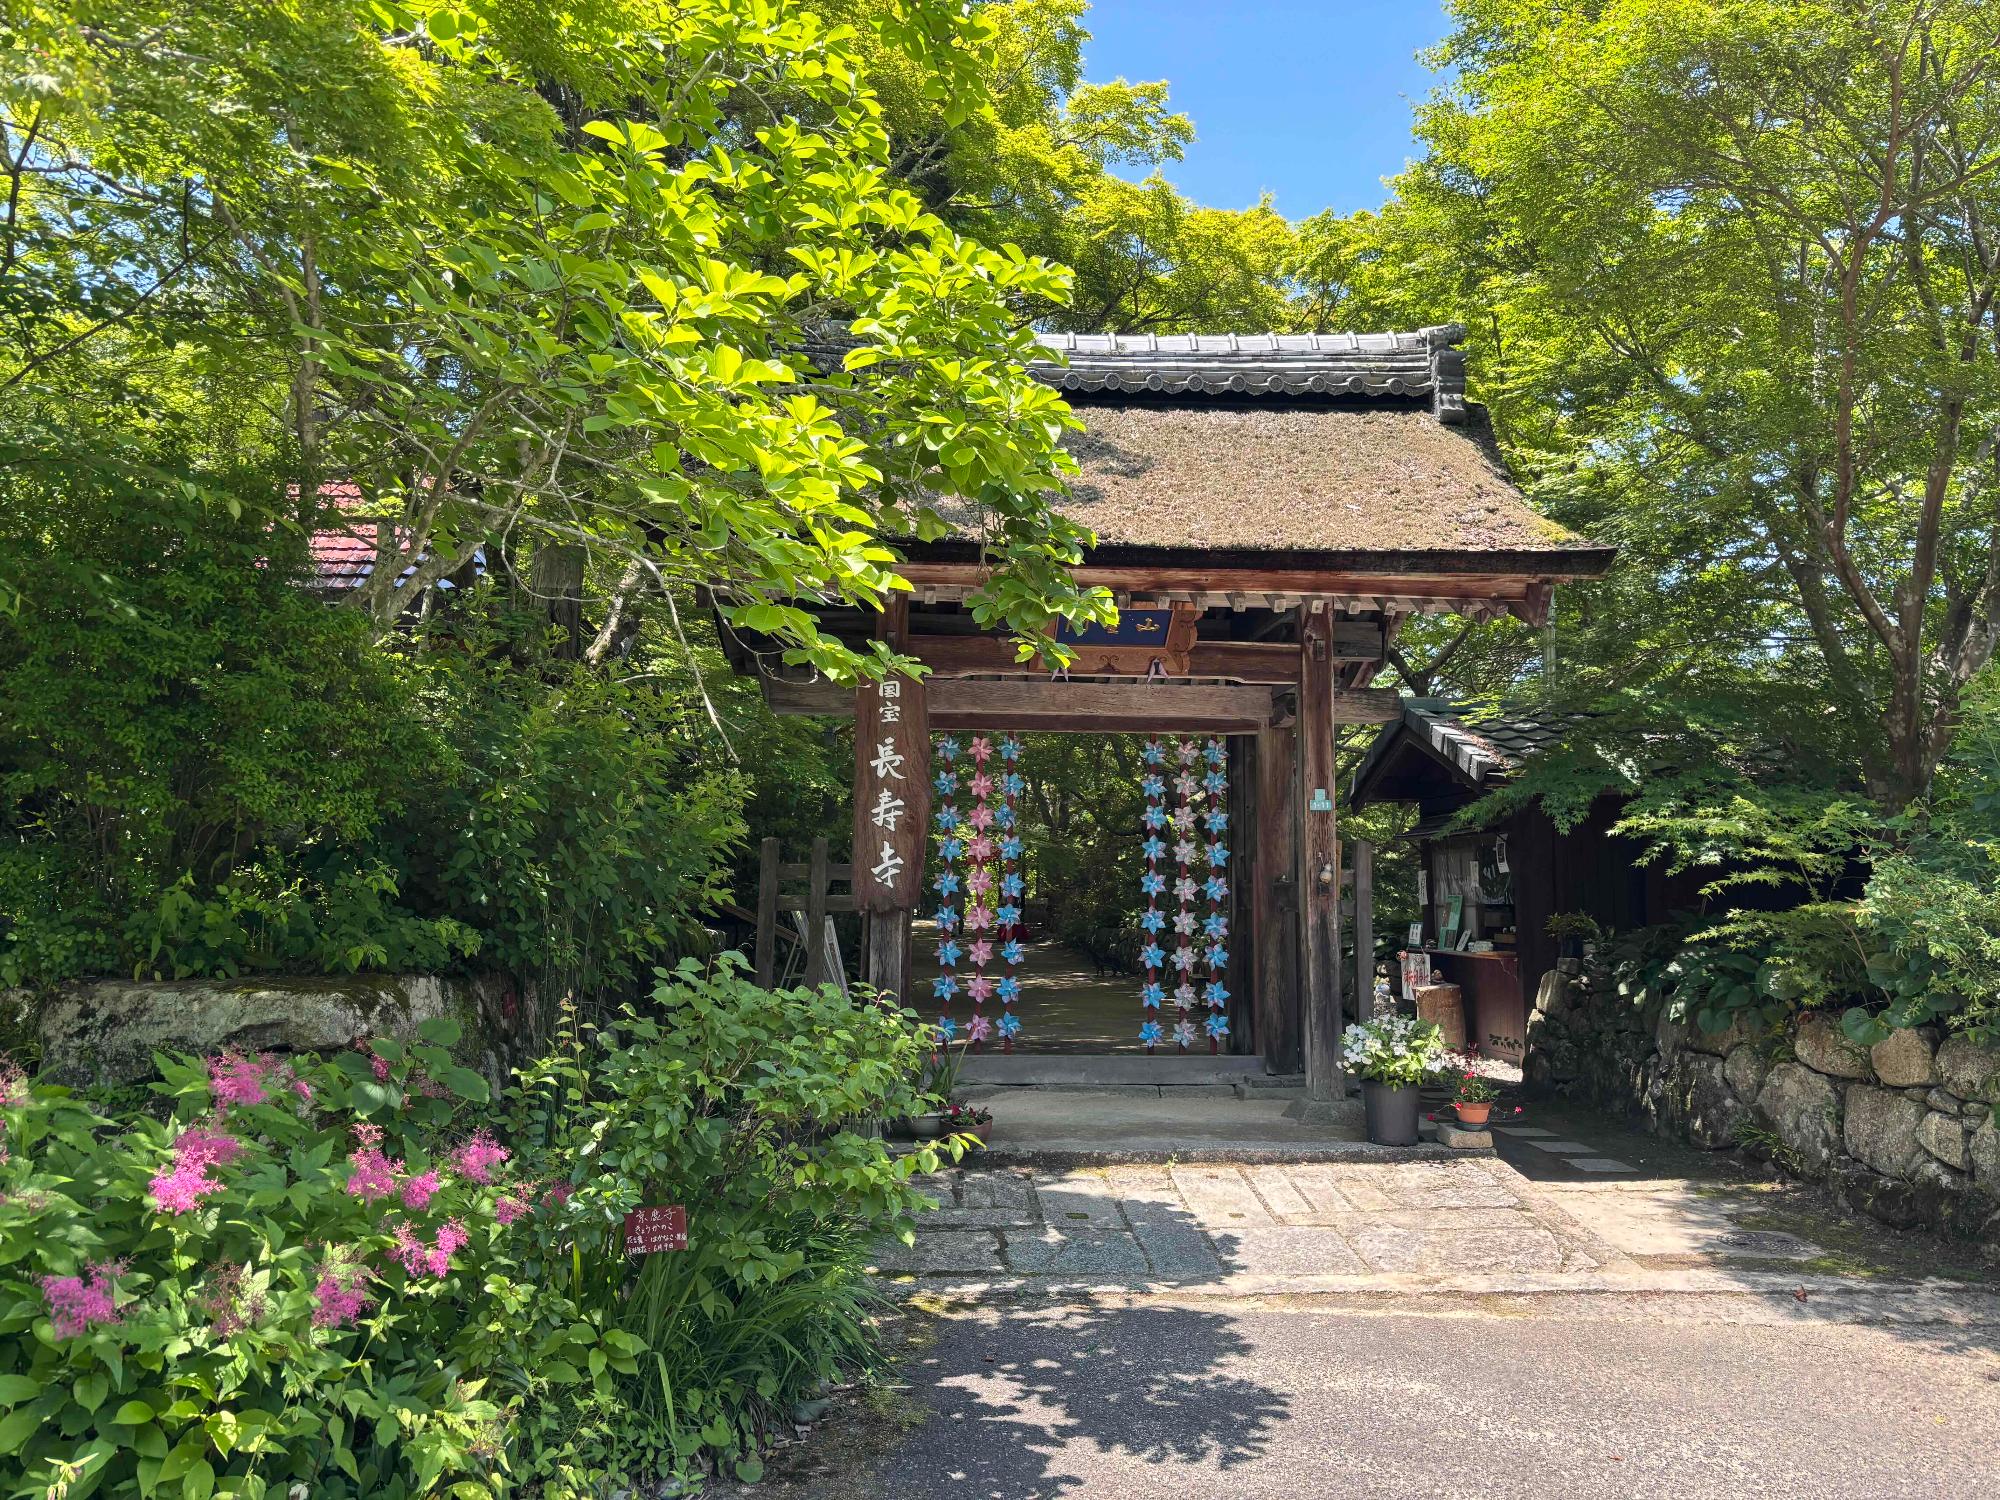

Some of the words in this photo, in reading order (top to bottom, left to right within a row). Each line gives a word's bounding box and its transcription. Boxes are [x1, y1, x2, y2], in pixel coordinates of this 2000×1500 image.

[879, 680, 901, 723] 国宝
[869, 736, 907, 889] 長寿寺
